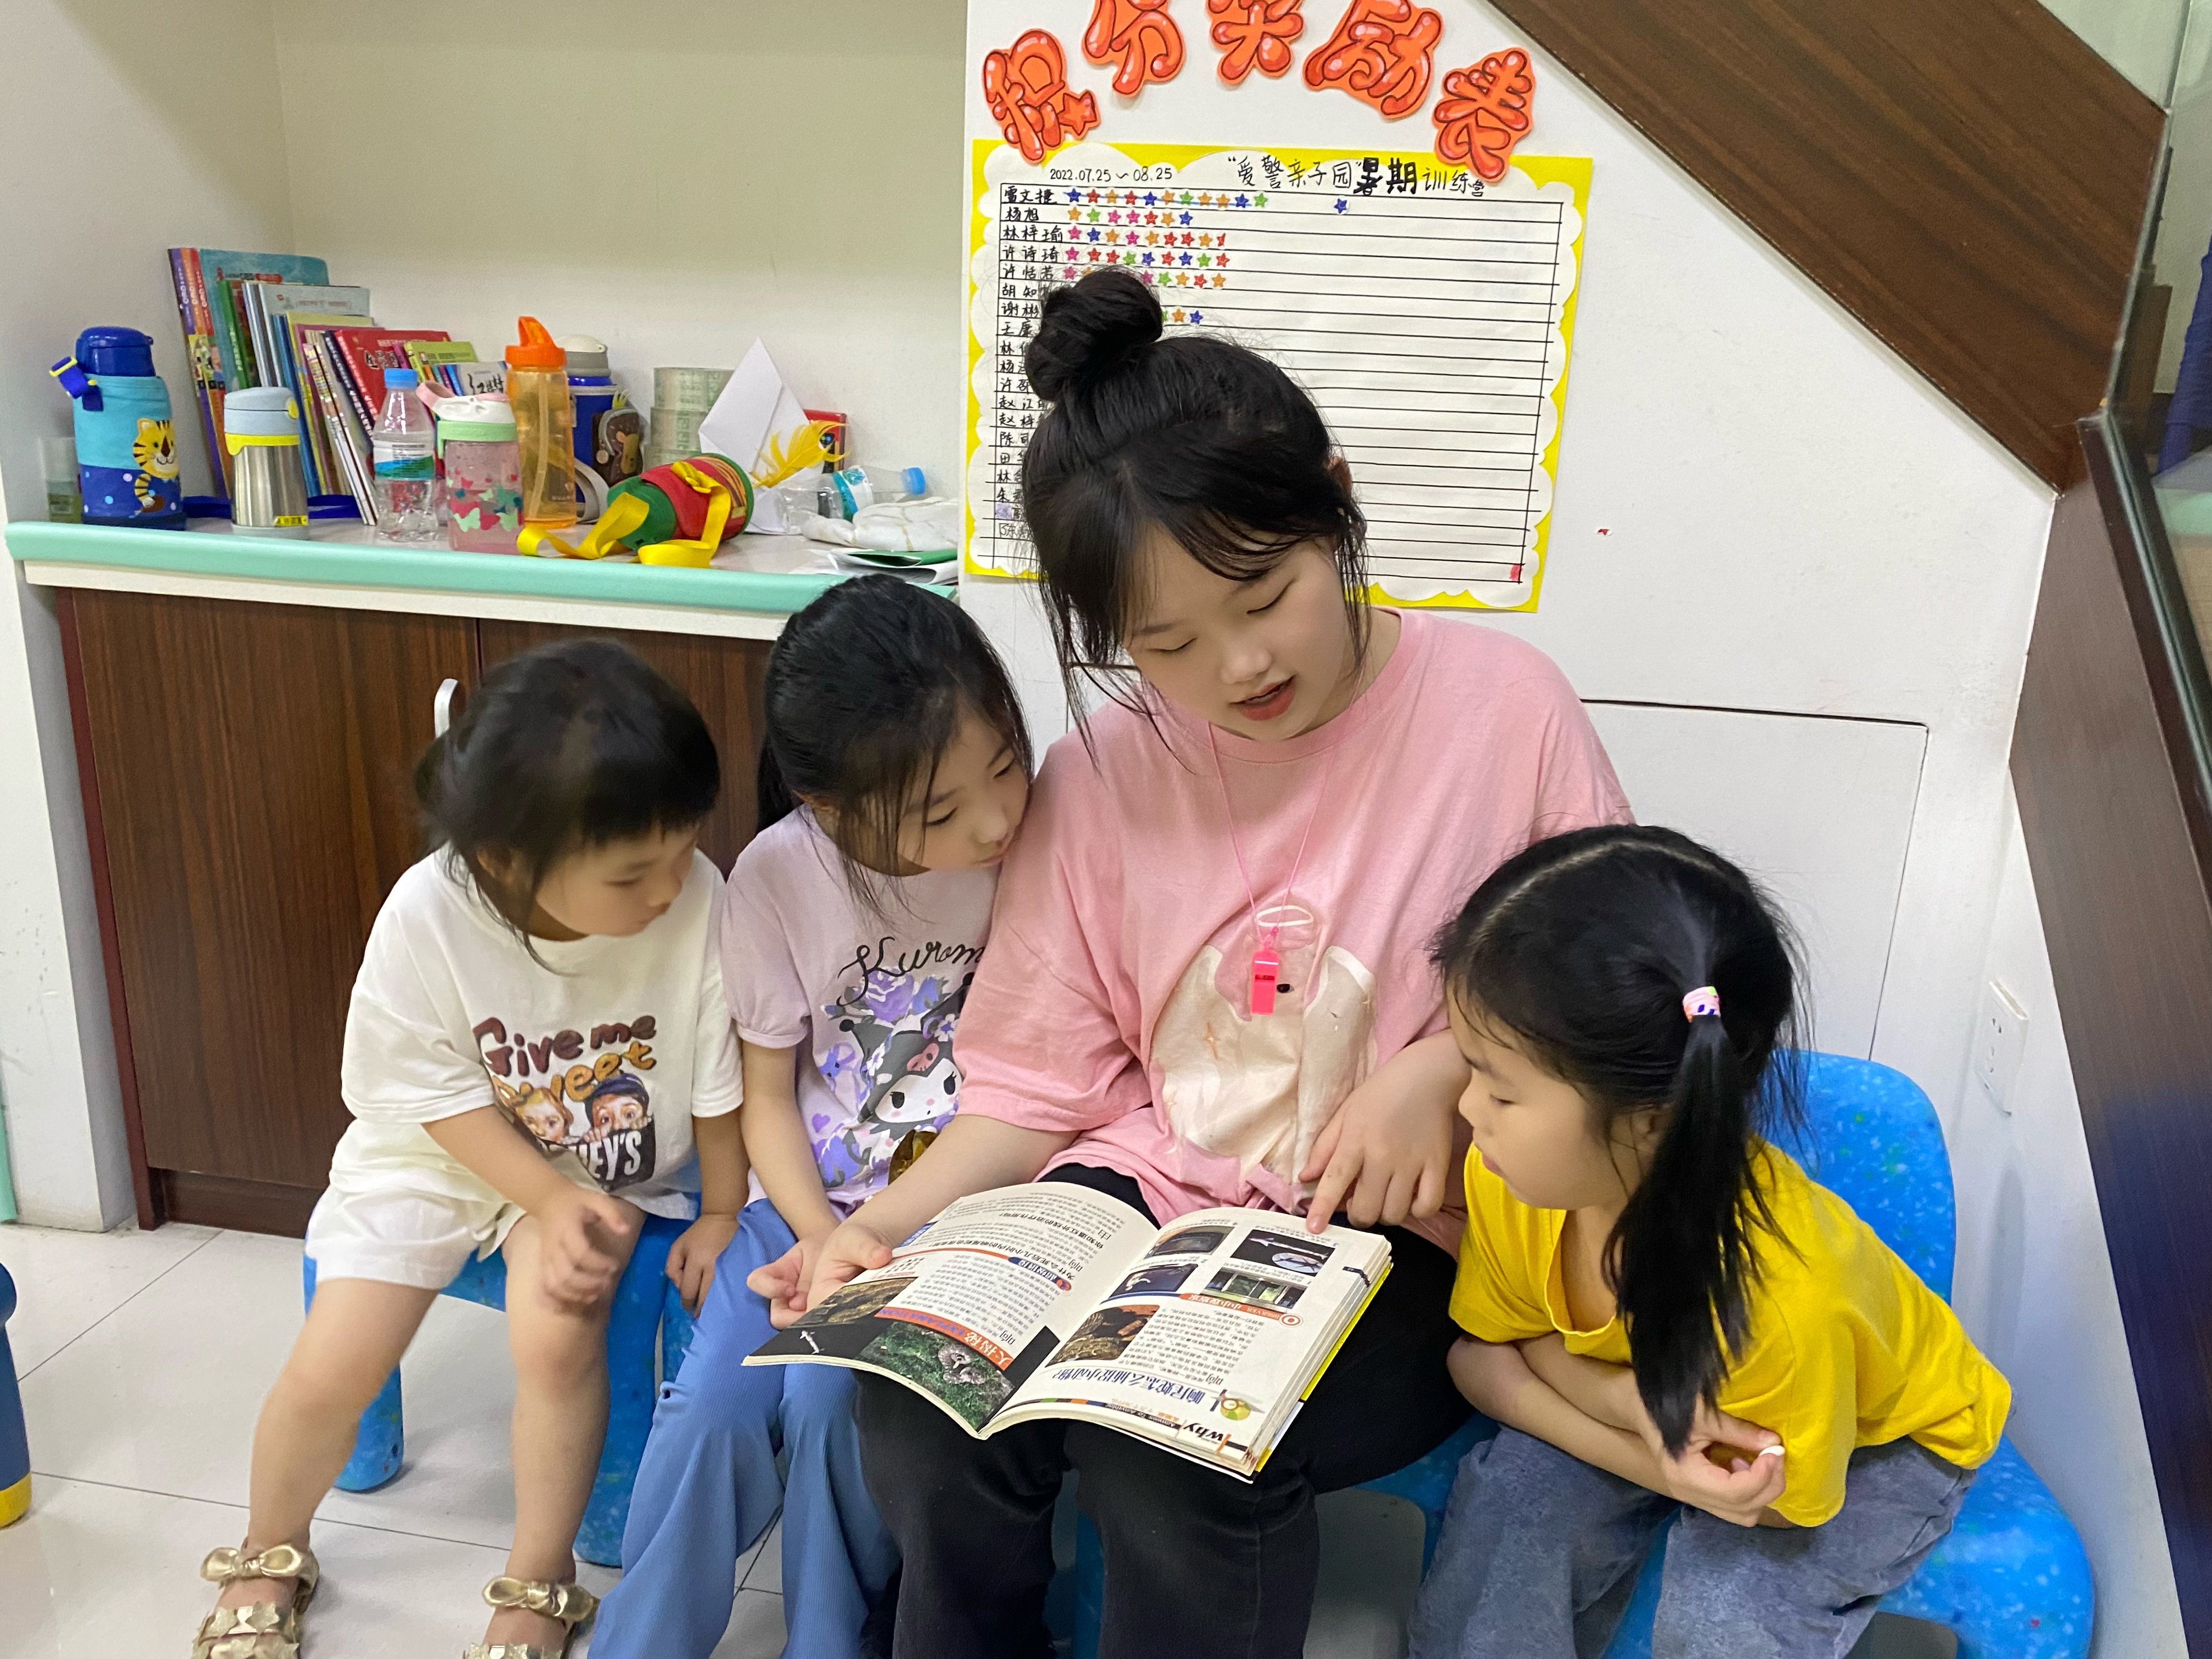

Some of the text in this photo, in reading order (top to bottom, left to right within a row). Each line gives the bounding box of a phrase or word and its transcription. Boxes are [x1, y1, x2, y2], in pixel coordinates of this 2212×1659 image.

[472, 1015, 657, 1077] Give me
[1183, 1423, 1224, 1442] why
